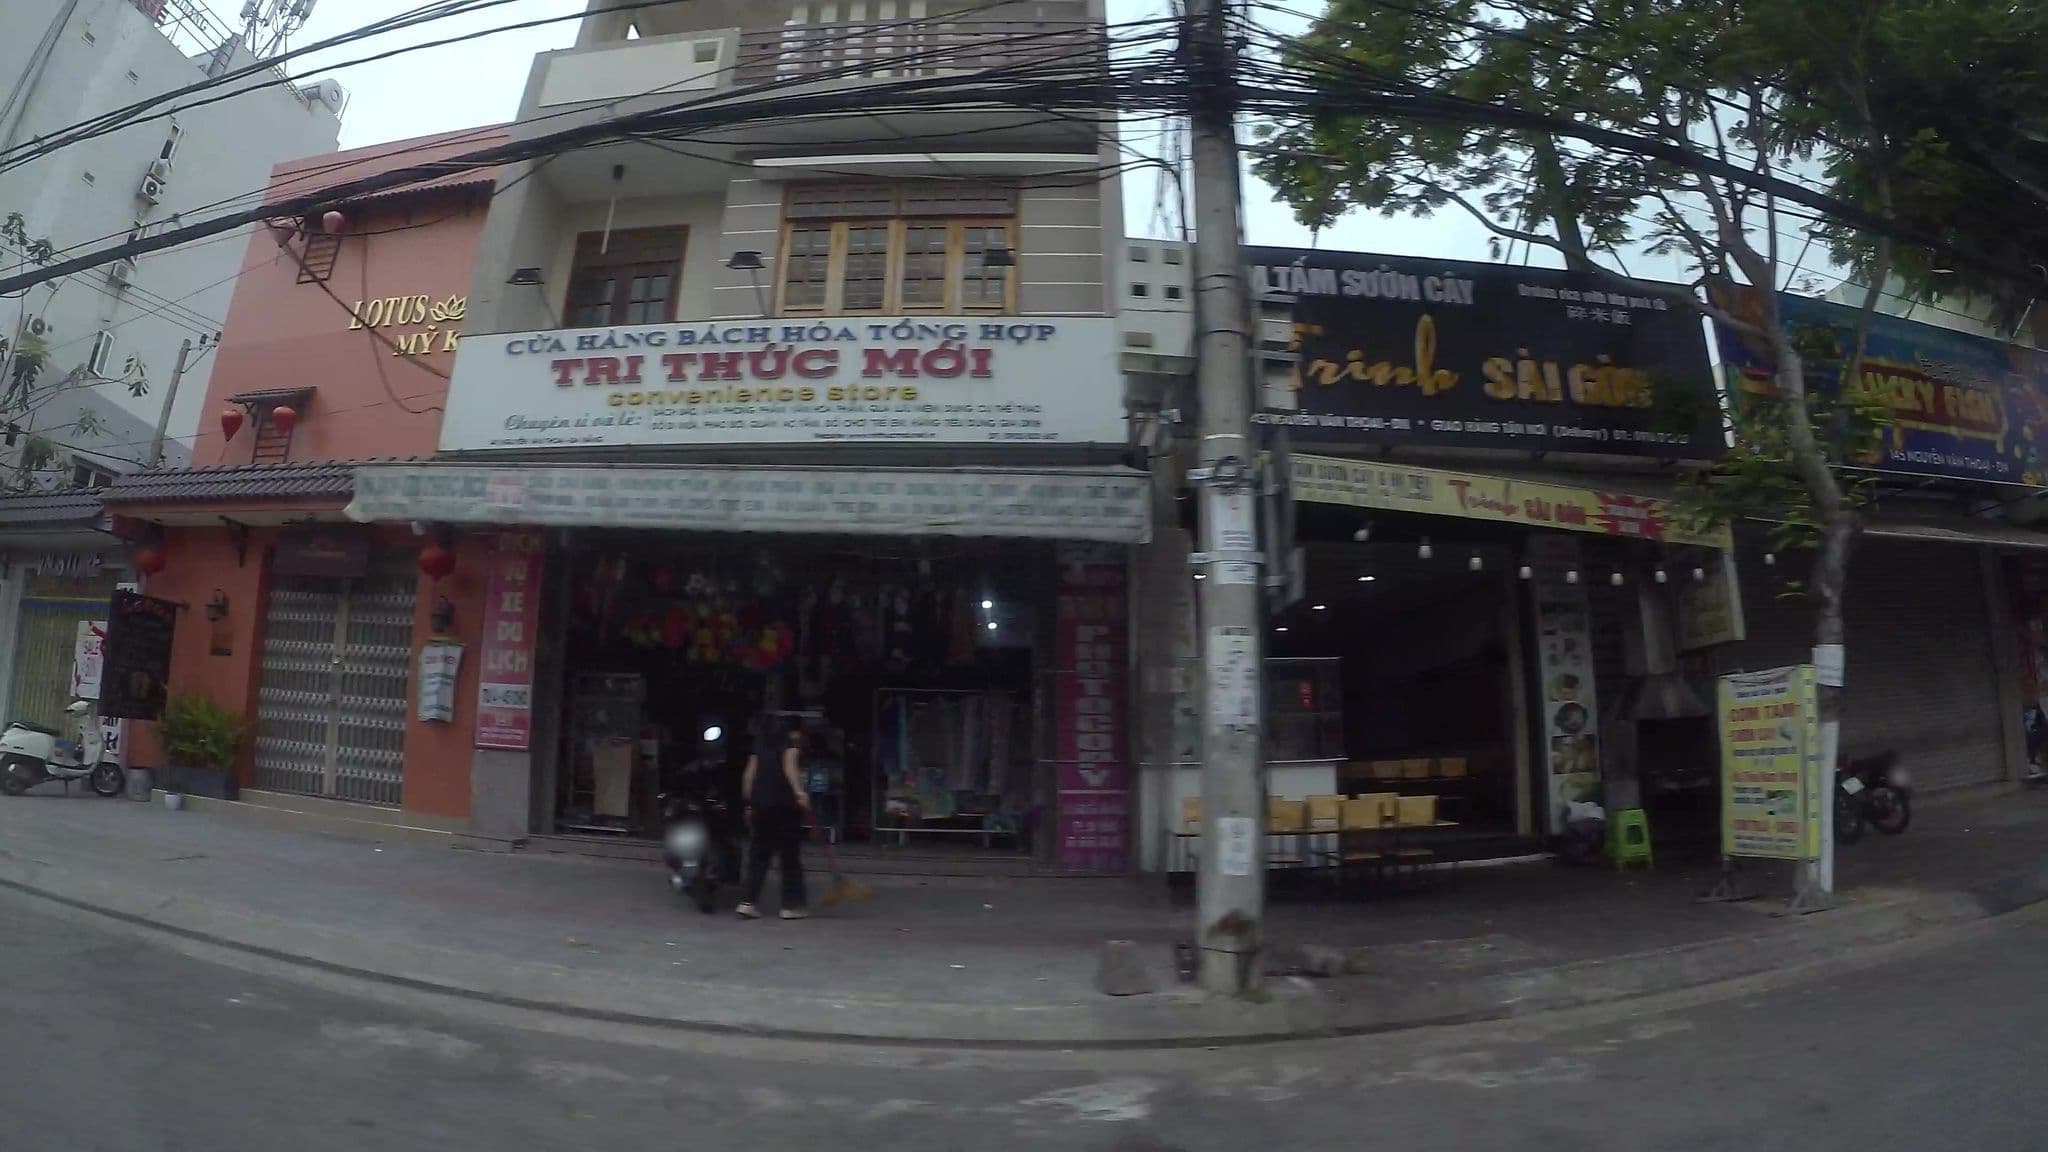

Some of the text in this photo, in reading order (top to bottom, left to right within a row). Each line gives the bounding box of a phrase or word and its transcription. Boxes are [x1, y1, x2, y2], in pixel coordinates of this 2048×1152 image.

[348, 294, 429, 330] LOTUS
[392, 324, 439, 356] MỸ
[575, 329, 667, 351] HÀNG
[677, 323, 772, 347] BÁCH
[781, 320, 857, 343] HÓA
[868, 318, 968, 342] TỔNG
[978, 323, 1056, 346] HỢP
[551, 339, 993, 387] TRI THỨC MỚI
[606, 383, 919, 407] convenience store
